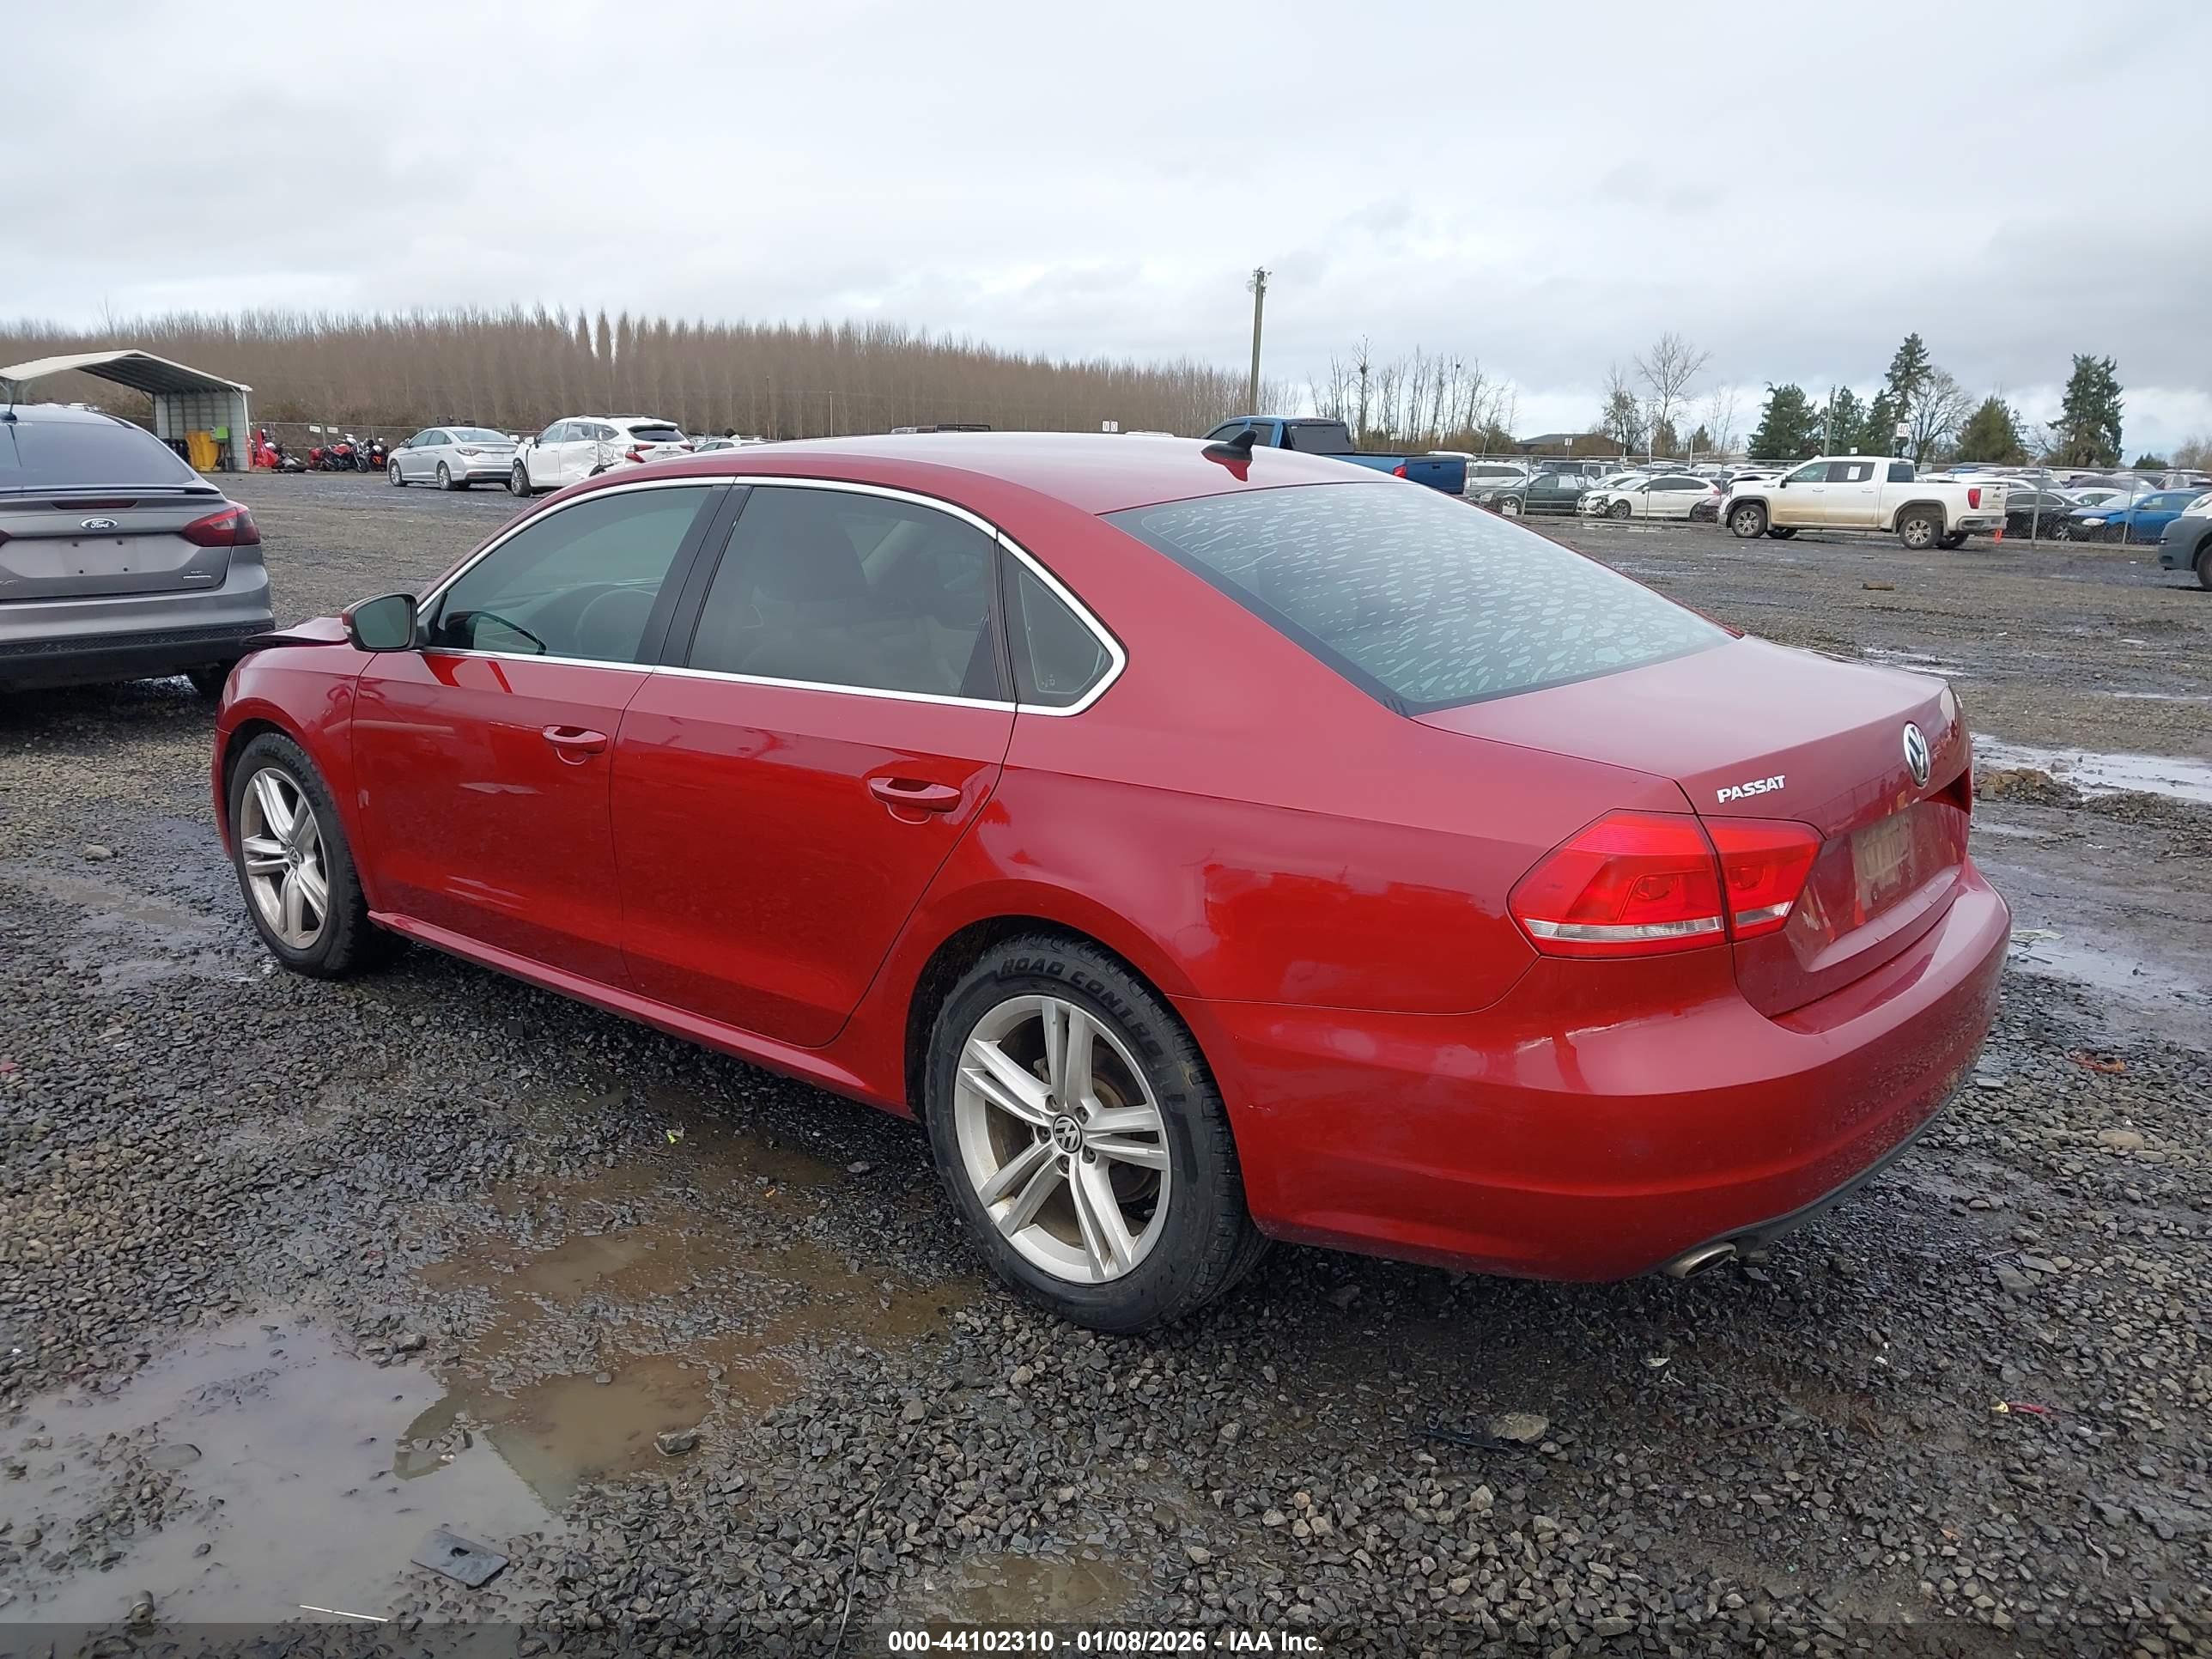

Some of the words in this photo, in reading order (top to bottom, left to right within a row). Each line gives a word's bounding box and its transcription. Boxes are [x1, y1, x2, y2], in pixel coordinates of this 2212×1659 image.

[1899, 425, 1909, 435] 40
[1717, 775, 1786, 804] PASSAT
[1000, 957, 1066, 978] ROAD
